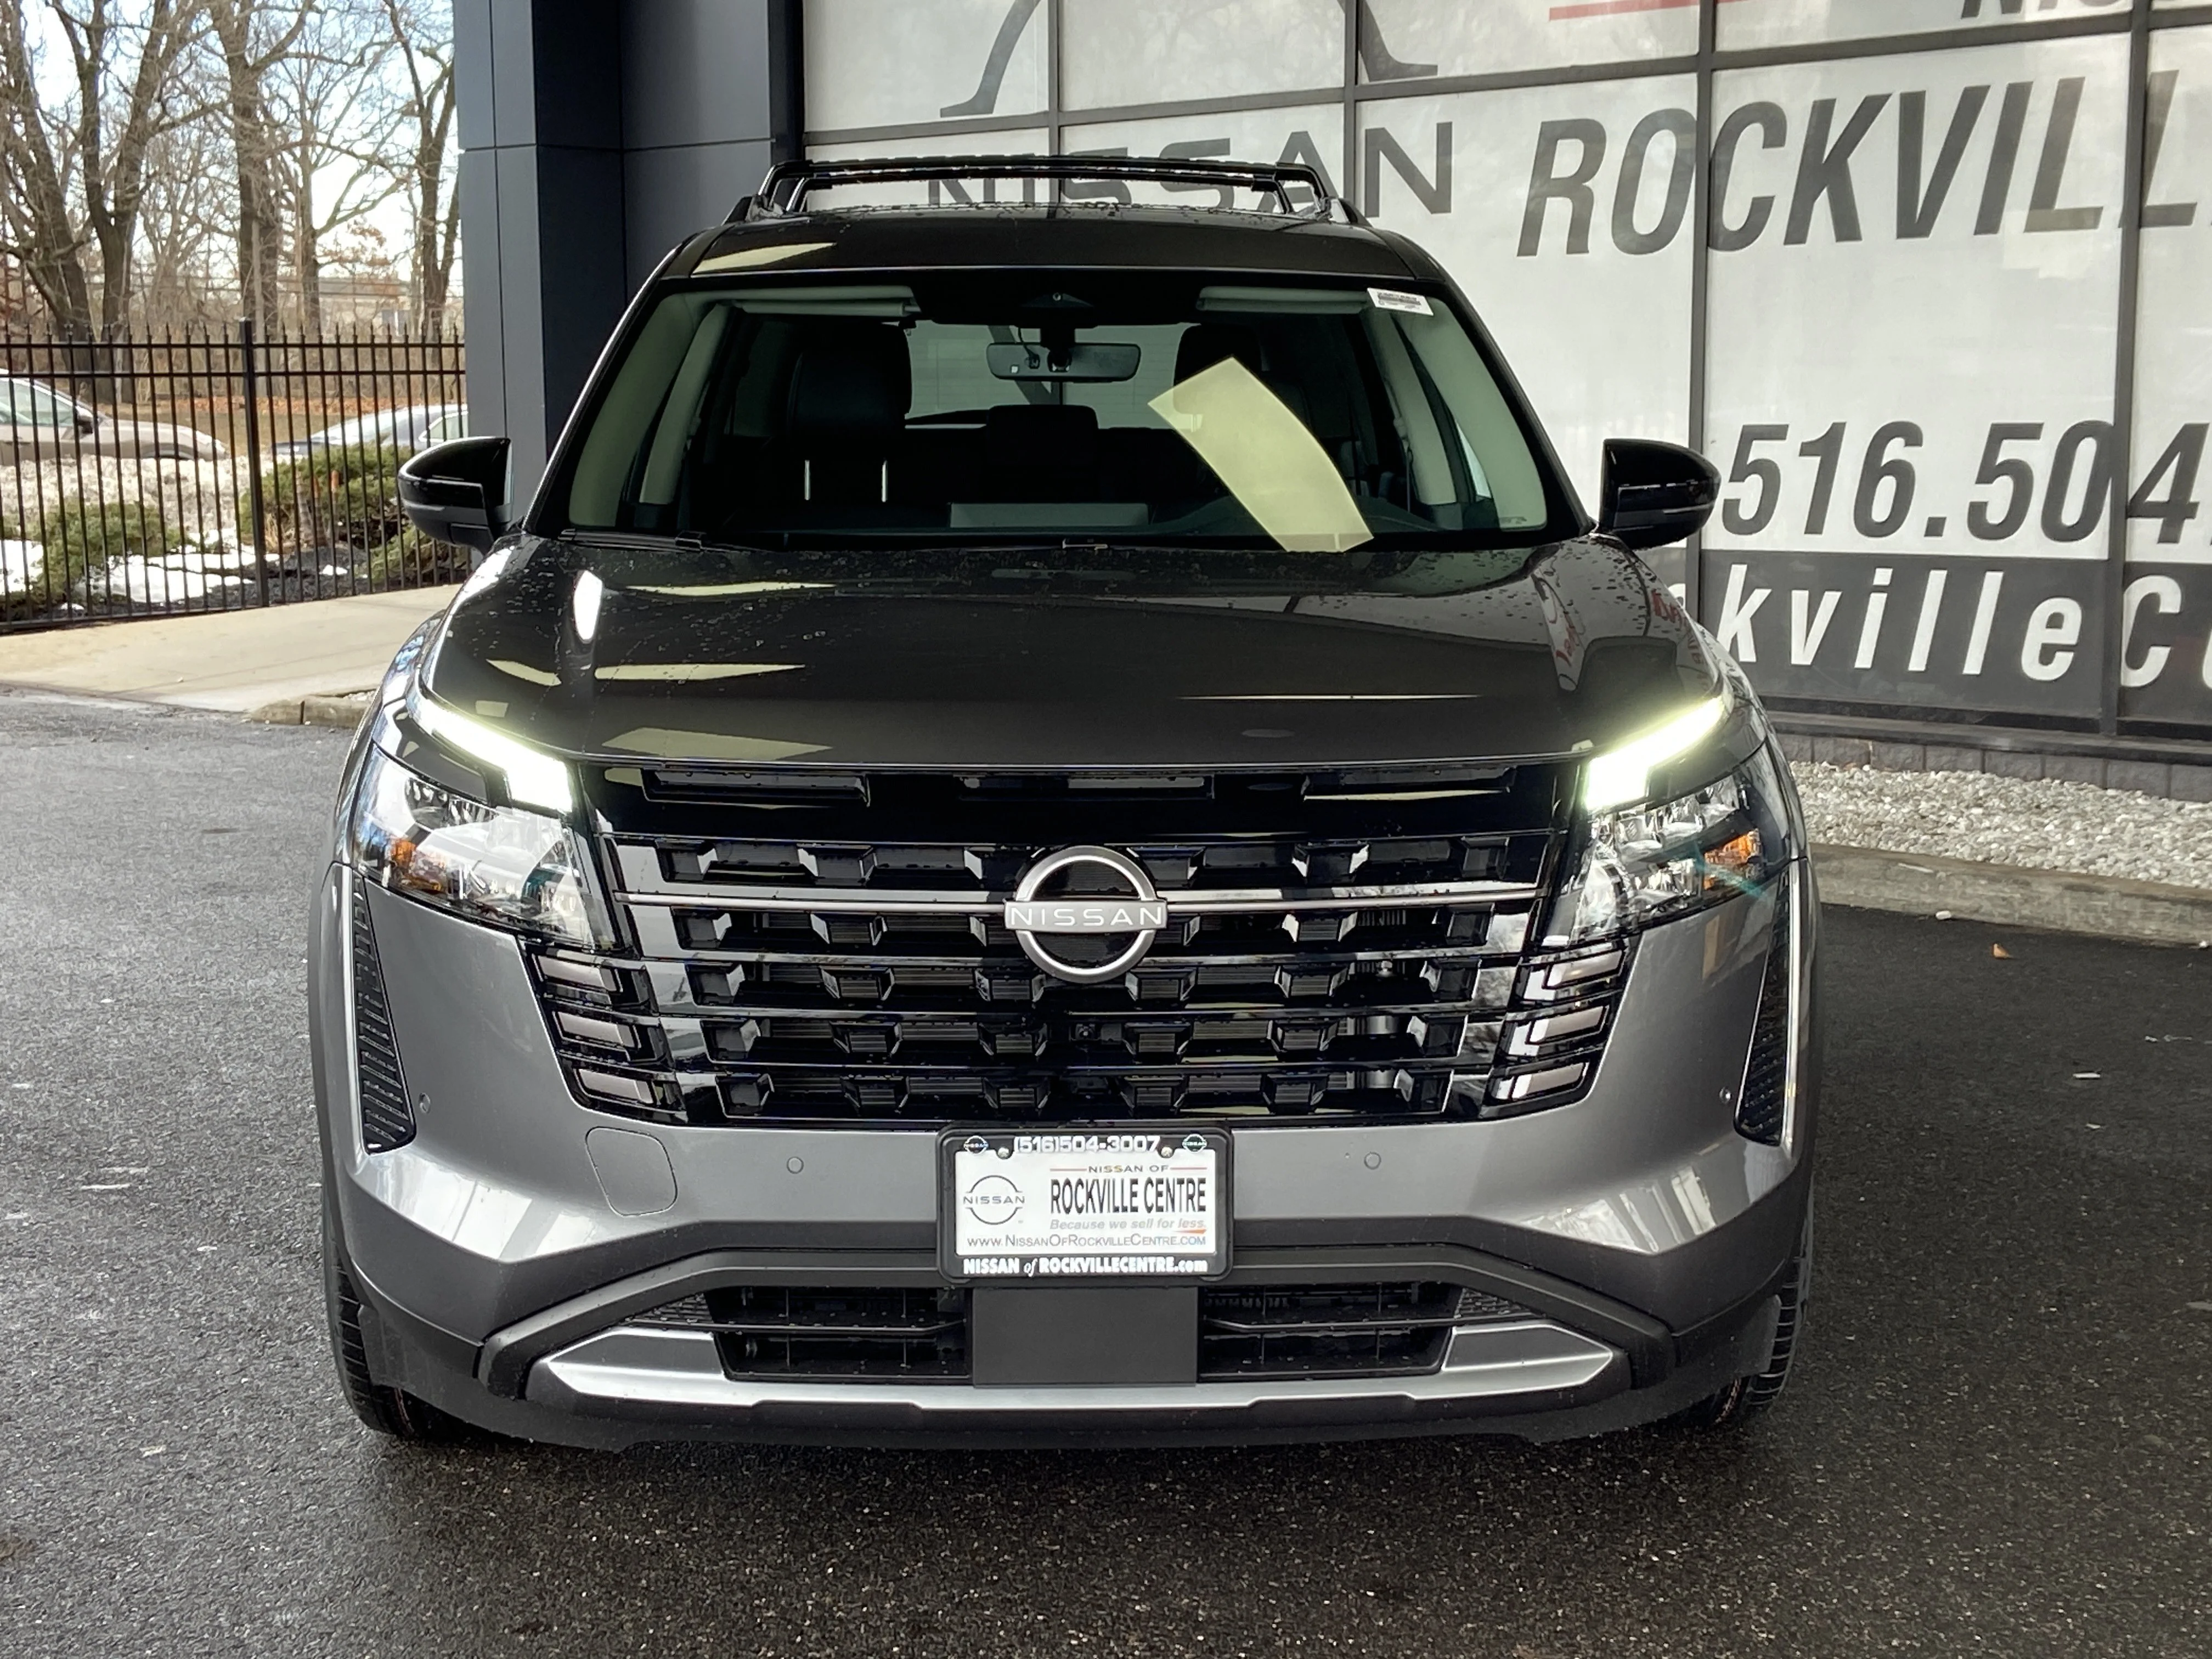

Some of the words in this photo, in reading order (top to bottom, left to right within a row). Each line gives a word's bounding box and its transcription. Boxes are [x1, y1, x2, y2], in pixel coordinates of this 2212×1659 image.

[928, 122, 1452, 218] SSAN
[1517, 69, 2212, 257] ROCKVILL
[1722, 421, 2212, 544] 516.504
[1011, 906, 1161, 926] NISSAN
[1014, 1135, 1160, 1153] (516)504-3007
[963, 1195, 1025, 1204] NISSAN
[1050, 1178, 1139, 1214] ROCKVILLE
[1144, 1177, 1206, 1214] CENTRE
[1049, 1218, 1105, 1229] Because
[1109, 1221, 1127, 1229] we
[1131, 1217, 1153, 1228] sell
[1156, 1217, 1175, 1228] for
[963, 1257, 1020, 1274] NISSAN
[1023, 1258, 1038, 1277] of
[1039, 1256, 1207, 1274] ROCKVILLECENTRE.com
